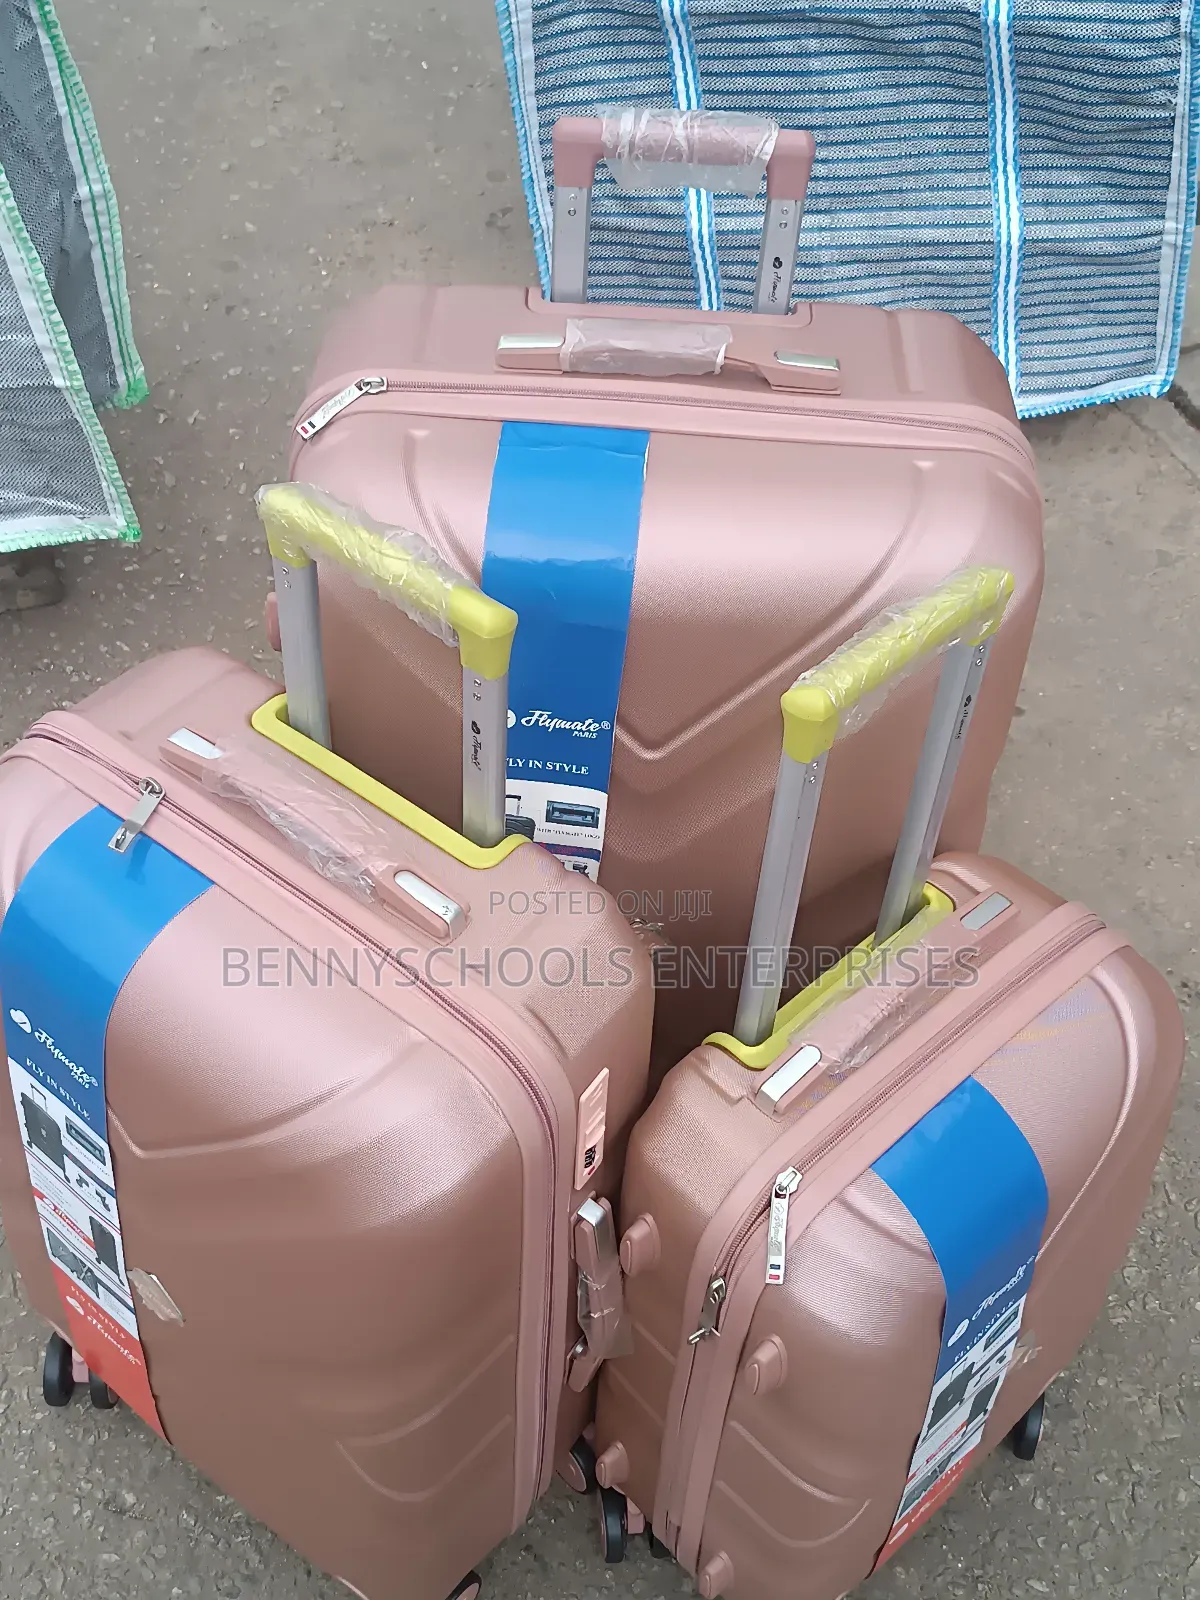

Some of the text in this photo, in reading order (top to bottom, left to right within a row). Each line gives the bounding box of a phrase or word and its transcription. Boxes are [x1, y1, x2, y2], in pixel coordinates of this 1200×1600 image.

[572, 730, 599, 739] PARIS
[506, 757, 590, 775] LY IN STYLE
